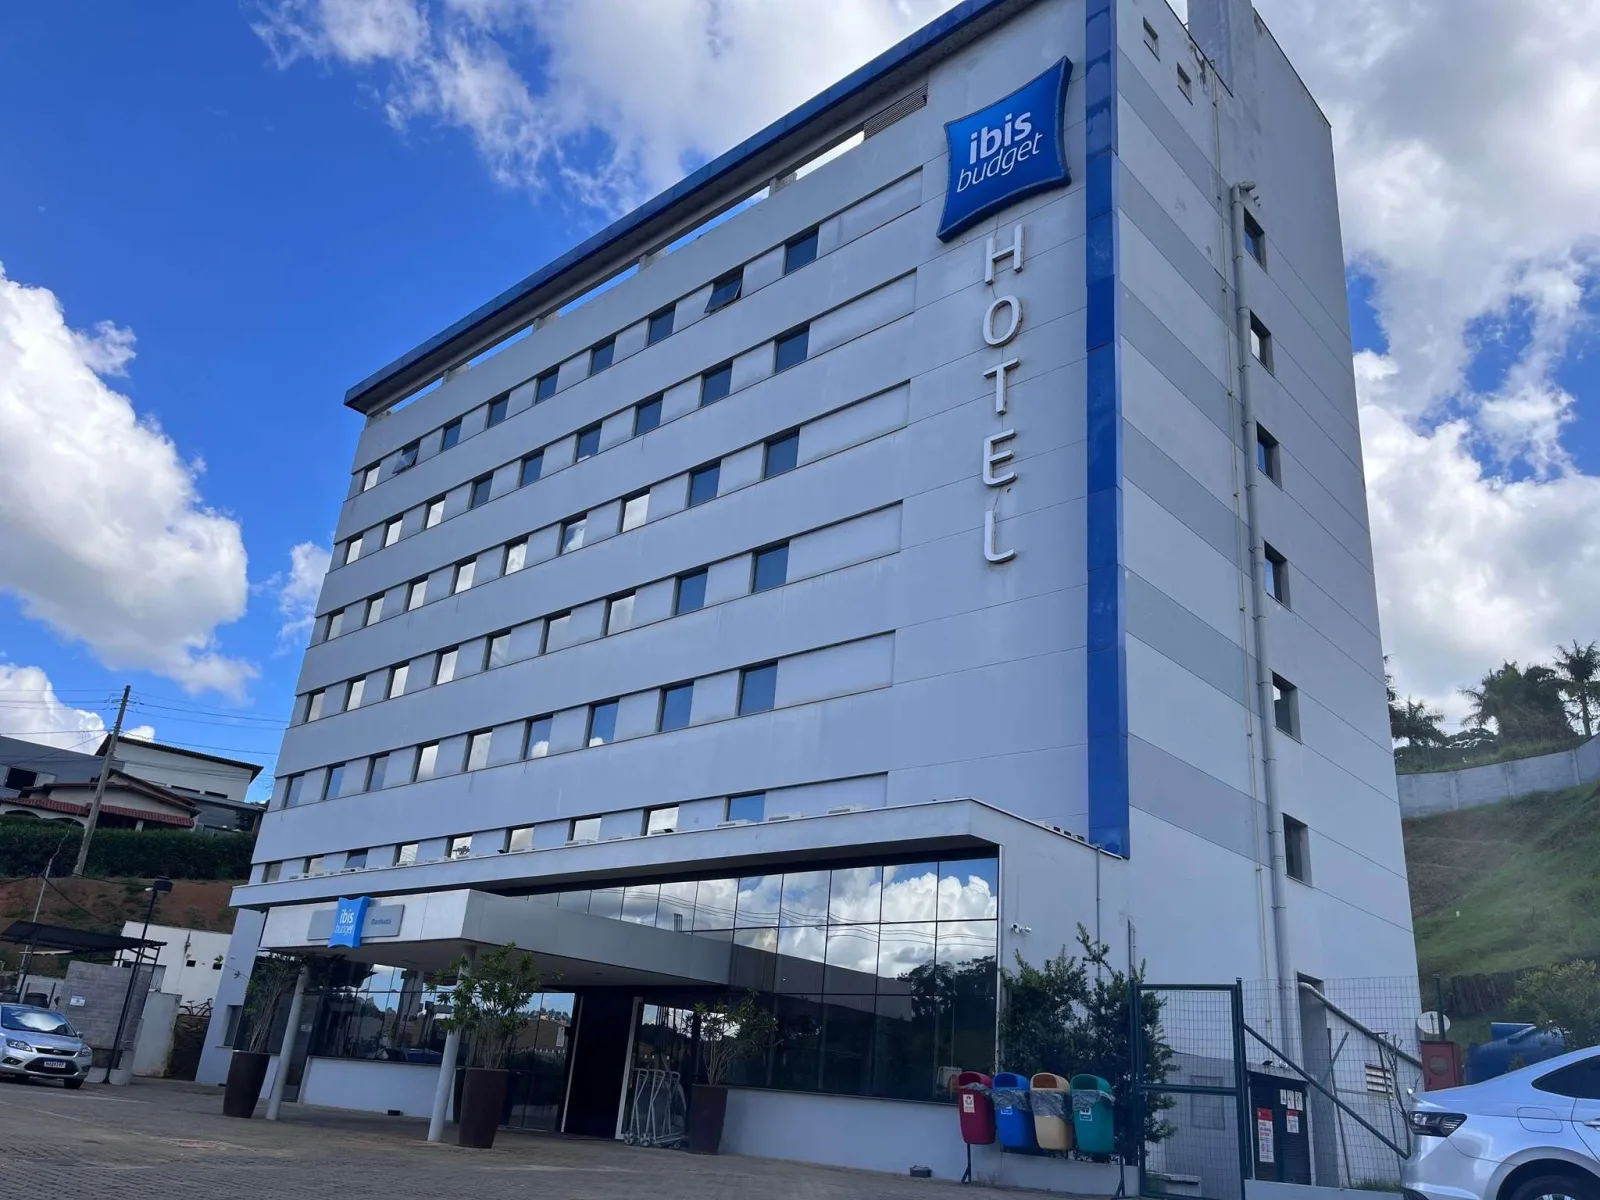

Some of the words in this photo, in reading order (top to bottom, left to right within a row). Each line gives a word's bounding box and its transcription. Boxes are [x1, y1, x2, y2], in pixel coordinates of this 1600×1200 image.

[956, 132, 1044, 193] budget
[969, 111, 1033, 165] ibis
[982, 223, 1025, 564] HOTEL
[334, 924, 354, 936] budget
[339, 908, 354, 924] ibis
